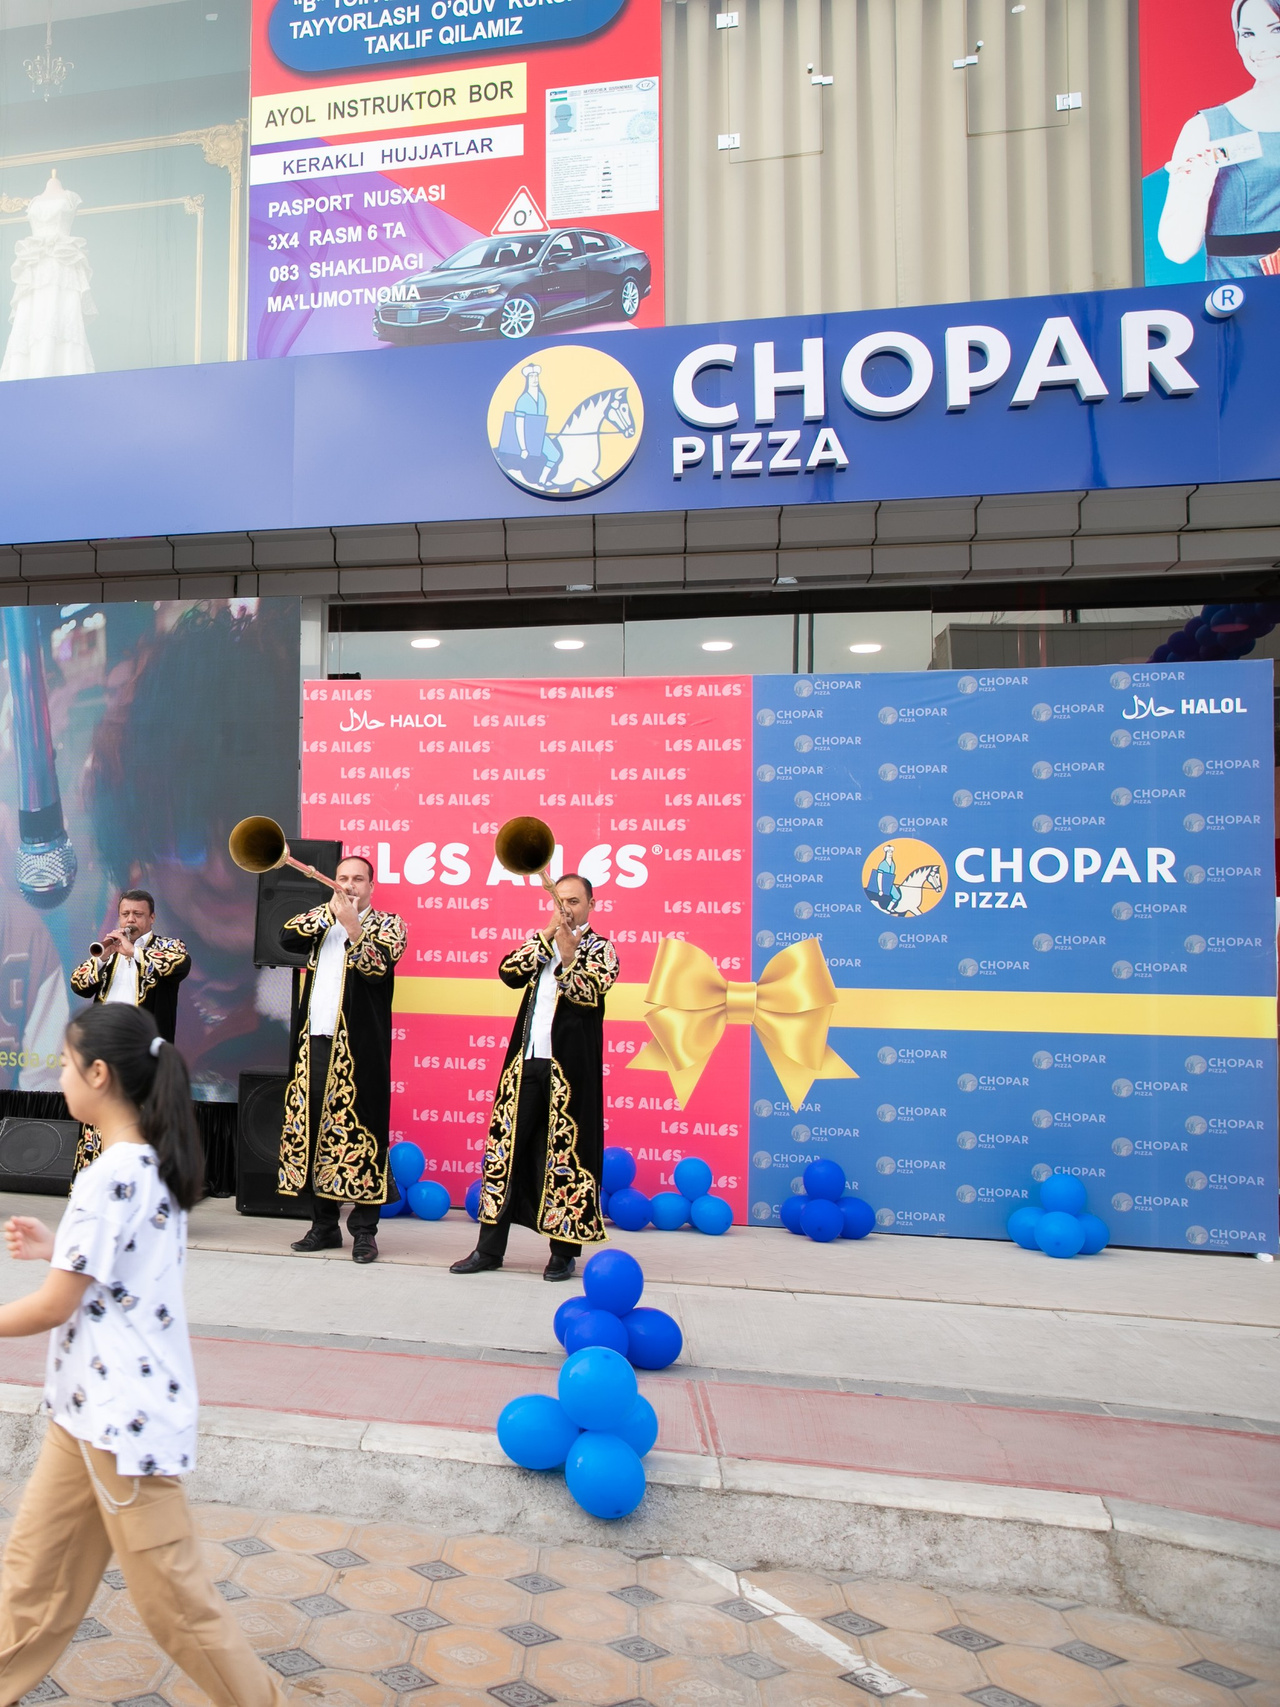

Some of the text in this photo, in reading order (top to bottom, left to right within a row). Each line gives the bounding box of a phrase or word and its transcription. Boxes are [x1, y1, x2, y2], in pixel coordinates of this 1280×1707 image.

[289, 4, 421, 39] TAYYORLASH
[364, 16, 523, 54] TAKLIF QILAMIZ
[265, 80, 513, 129] AYOL INSTRUKTOR BOR
[283, 137, 493, 175] KERAKLI HUJJATLAR
[268, 184, 446, 218] PASPORT NUSXASI
[268, 222, 406, 251] 3X4 RASM 6 TA
[269, 253, 424, 283] 083 SHAKLIDAGI
[267, 285, 421, 313] MA'LUMOTNOMA
[672, 309, 1201, 429] CHOPAR
[672, 425, 850, 479] PIZZA
[979, 676, 1028, 686] CHOPAR
[1133, 672, 1184, 682] CHOPAR
[303, 689, 327, 700] LES
[420, 688, 444, 700] LES
[540, 687, 566, 699] LES
[666, 685, 692, 697] LES
[1054, 704, 1104, 714] CHOPAR
[1181, 697, 1248, 714] HALOL
[899, 708, 947, 717] CHOPAR
[390, 713, 448, 728] HALOL
[474, 715, 499, 726] LES
[611, 714, 638, 726] LES
[420, 741, 444, 752] LES
[540, 740, 566, 752] LES
[666, 740, 692, 751] LES
[899, 765, 947, 774] CHOPAR
[1054, 762, 1104, 772] CHOPAR
[1206, 760, 1260, 769] CHOPAR
[341, 767, 365, 778] LES
[474, 769, 498, 780] LES
[611, 768, 638, 780] LES
[974, 791, 1024, 800] CHOPAR
[1134, 789, 1186, 798] CHOPAR
[419, 794, 444, 805] LES
[540, 794, 566, 806] LES
[666, 794, 692, 806] LES
[340, 820, 364, 830] LES
[611, 819, 637, 830] LES
[1054, 816, 1105, 825] CHOPAR
[1207, 815, 1260, 824] CHOPAR
[665, 849, 692, 860] LES
[815, 847, 862, 855] CHOPAR
[377, 842, 471, 886] LES
[955, 847, 1178, 883] CHOPAR
[776, 874, 823, 882] CHOPAR
[418, 897, 442, 908] LES
[955, 892, 1028, 908] PIZZA
[665, 901, 692, 913] LES
[1135, 904, 1187, 913] CHOPAR
[900, 934, 948, 943] CHOPAR
[417, 950, 442, 962] LES
[980, 960, 1030, 970] CHOPAR
[414, 1056, 440, 1068] LES
[1055, 1053, 1106, 1063] CHOPAR
[1209, 1058, 1263, 1068] CHOPAR
[1135, 1081, 1188, 1091] CHOPAR
[414, 1109, 438, 1121] LES
[662, 1122, 688, 1134] LES
[812, 1127, 859, 1137] CHOPAR
[1135, 1140, 1188, 1151] CHOPAR
[897, 1159, 946, 1170] CHOPAR
[978, 1187, 1028, 1198] CHOPAR
[1210, 1229, 1266, 1240] CHOPAR
